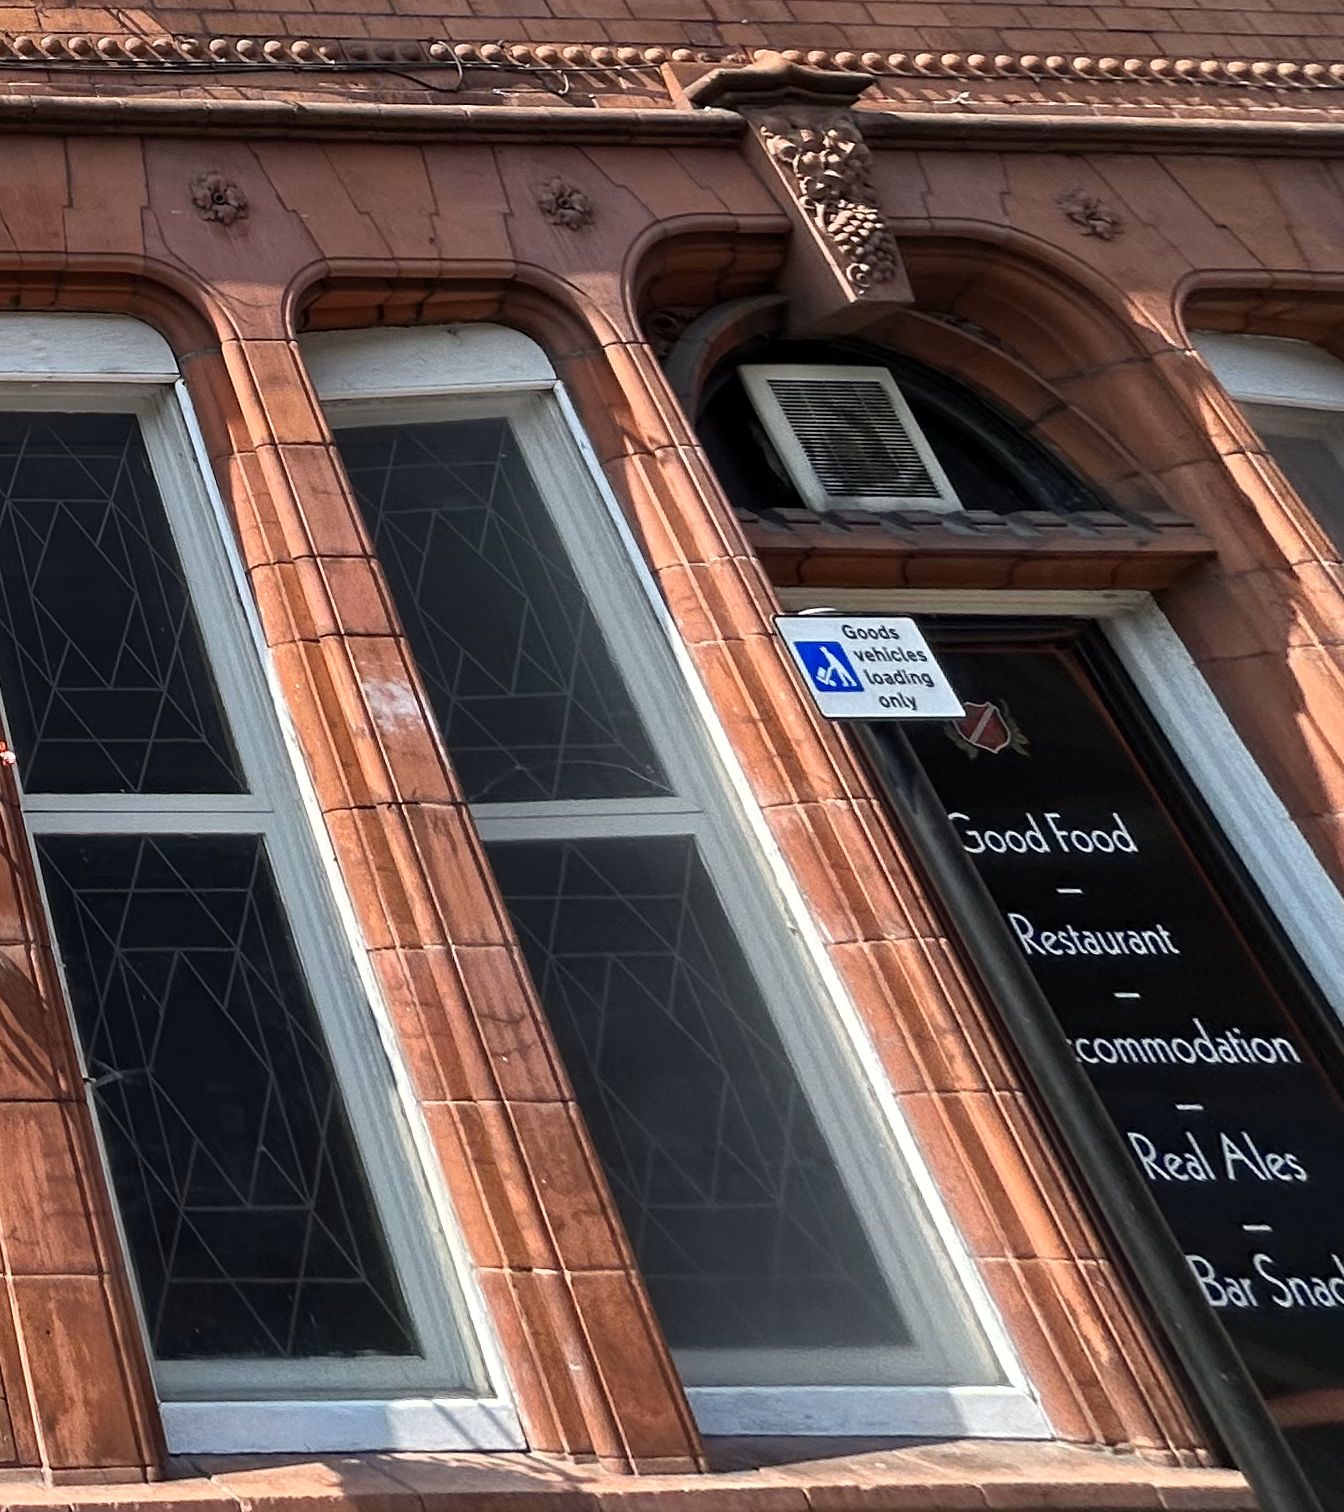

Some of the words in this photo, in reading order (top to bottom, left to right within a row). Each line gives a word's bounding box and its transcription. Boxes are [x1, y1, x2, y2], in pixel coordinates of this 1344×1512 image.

[841, 623, 900, 640] Goods
[853, 646, 928, 663] vehicles
[863, 669, 935, 688] loading
[878, 691, 918, 711] only
[947, 811, 1052, 854] Good
[1043, 811, 1139, 854] Food
[1007, 912, 1181, 956] Restaurant
[1065, 1017, 1302, 1065] commodation
[1127, 1130, 1217, 1182] Real
[1219, 1130, 1309, 1182] Ales
[1184, 1253, 1260, 1308] Bar
